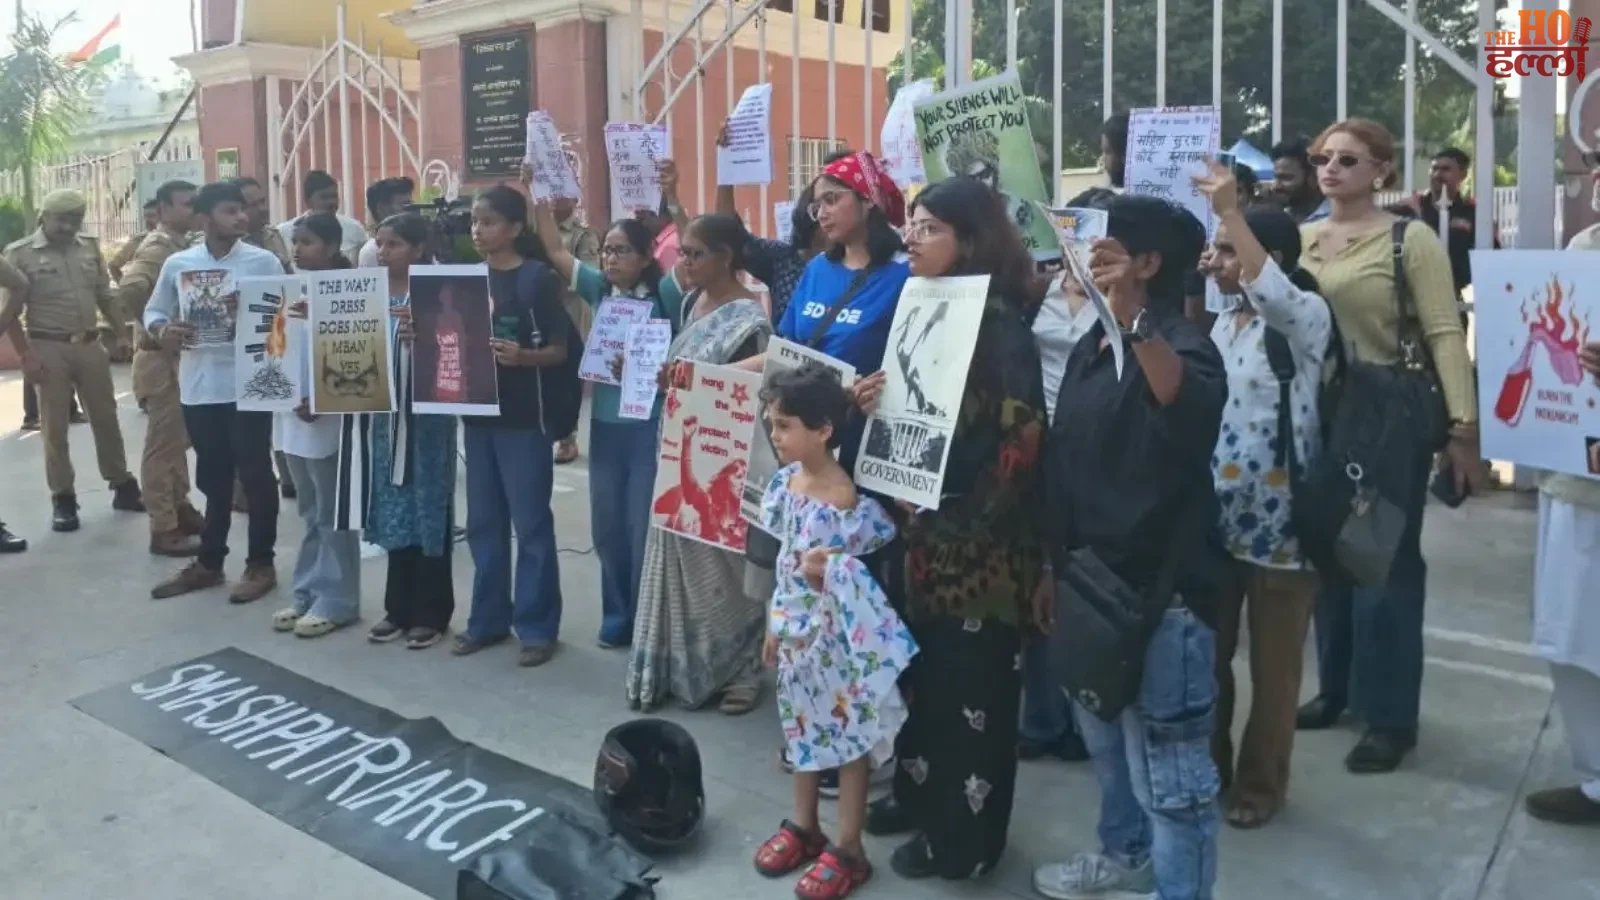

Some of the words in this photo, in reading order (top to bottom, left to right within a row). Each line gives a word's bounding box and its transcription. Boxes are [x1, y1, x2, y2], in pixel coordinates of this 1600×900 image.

[945, 92, 990, 119] SILENCE
[989, 85, 1020, 106] WILL
[924, 128, 945, 153] NOT
[946, 114, 997, 145] PROTECT
[318, 280, 342, 295] THE
[344, 278, 368, 293] WAY
[330, 299, 366, 314] DRESS
[352, 320, 379, 333] NOT
[701, 376, 725, 392] hang
[714, 399, 729, 411] the
[698, 425, 731, 440] protect
[734, 439, 748, 451] the
[700, 443, 728, 457] victim
[860, 460, 937, 494] GOVERNMENT
